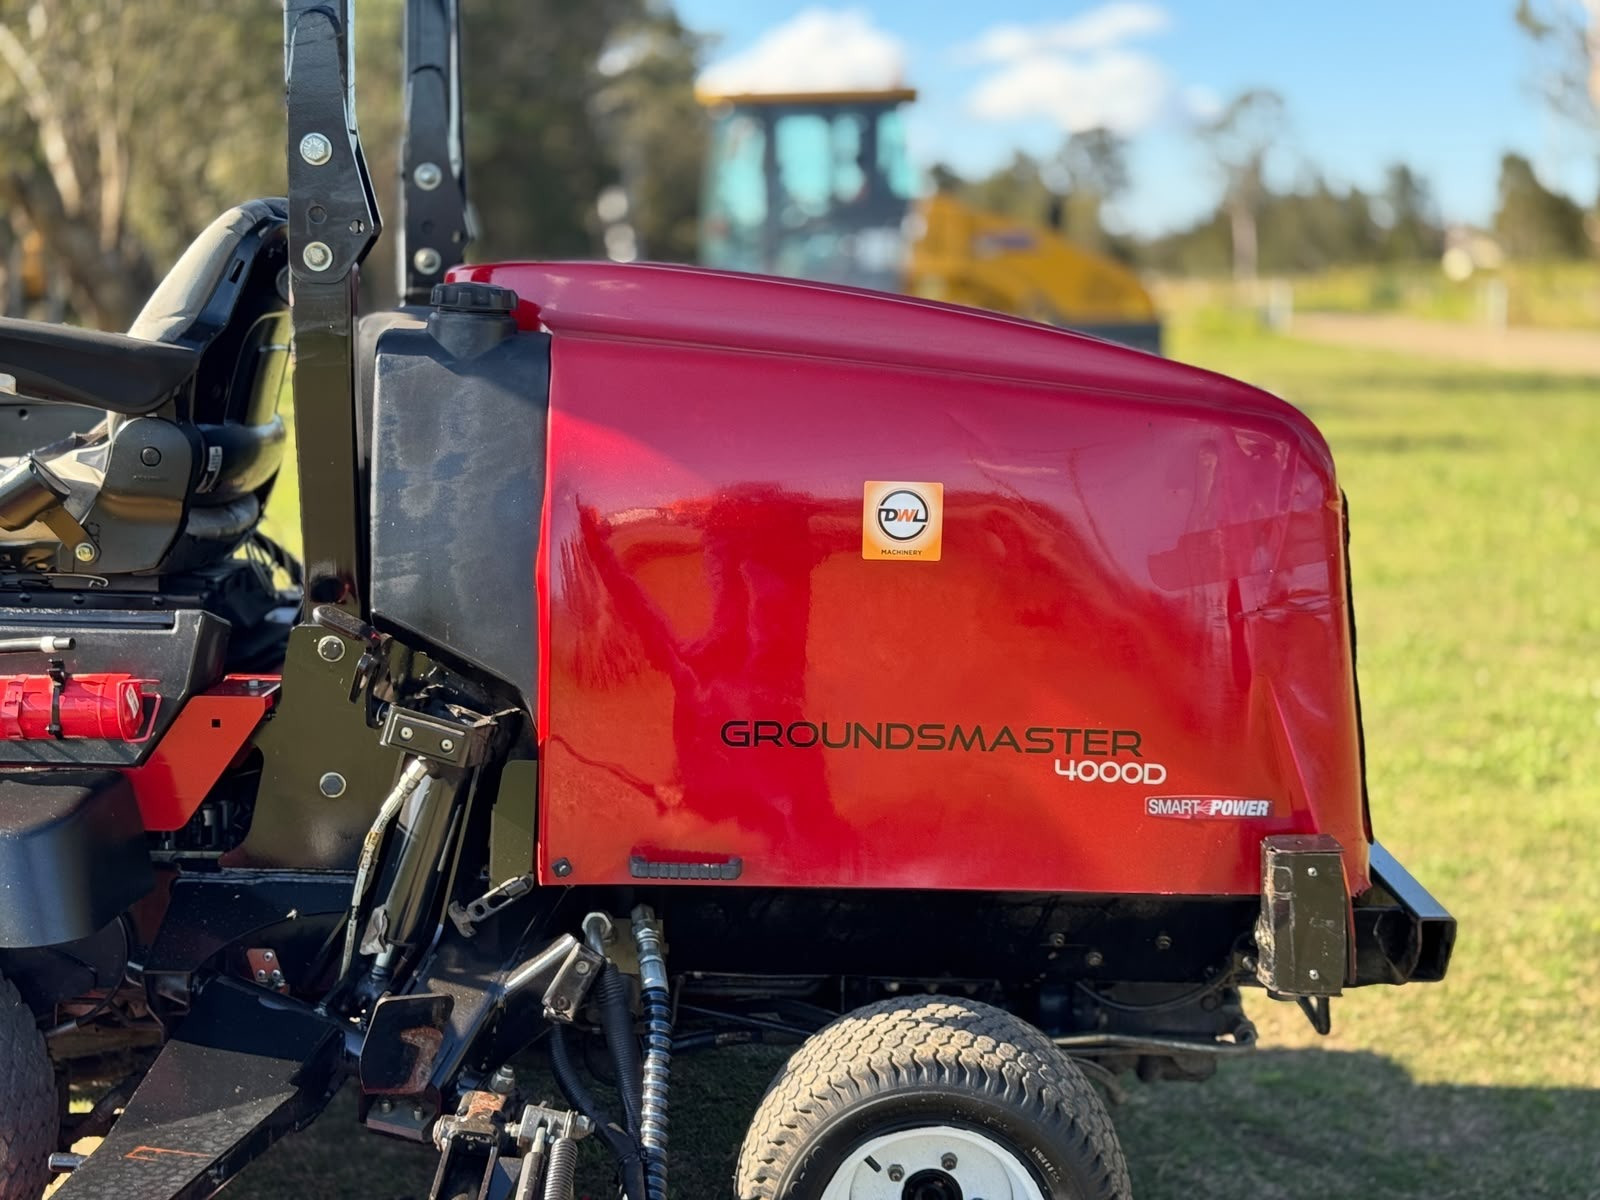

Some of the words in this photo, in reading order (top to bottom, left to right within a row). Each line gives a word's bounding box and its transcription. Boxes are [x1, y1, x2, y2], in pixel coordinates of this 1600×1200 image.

[878, 508, 929, 523] DWL
[721, 720, 1143, 758] GROUNDSMASTER
[1055, 759, 1167, 785] 4000D
[1148, 798, 1200, 815] SMART
[1209, 799, 1270, 816] POWER
